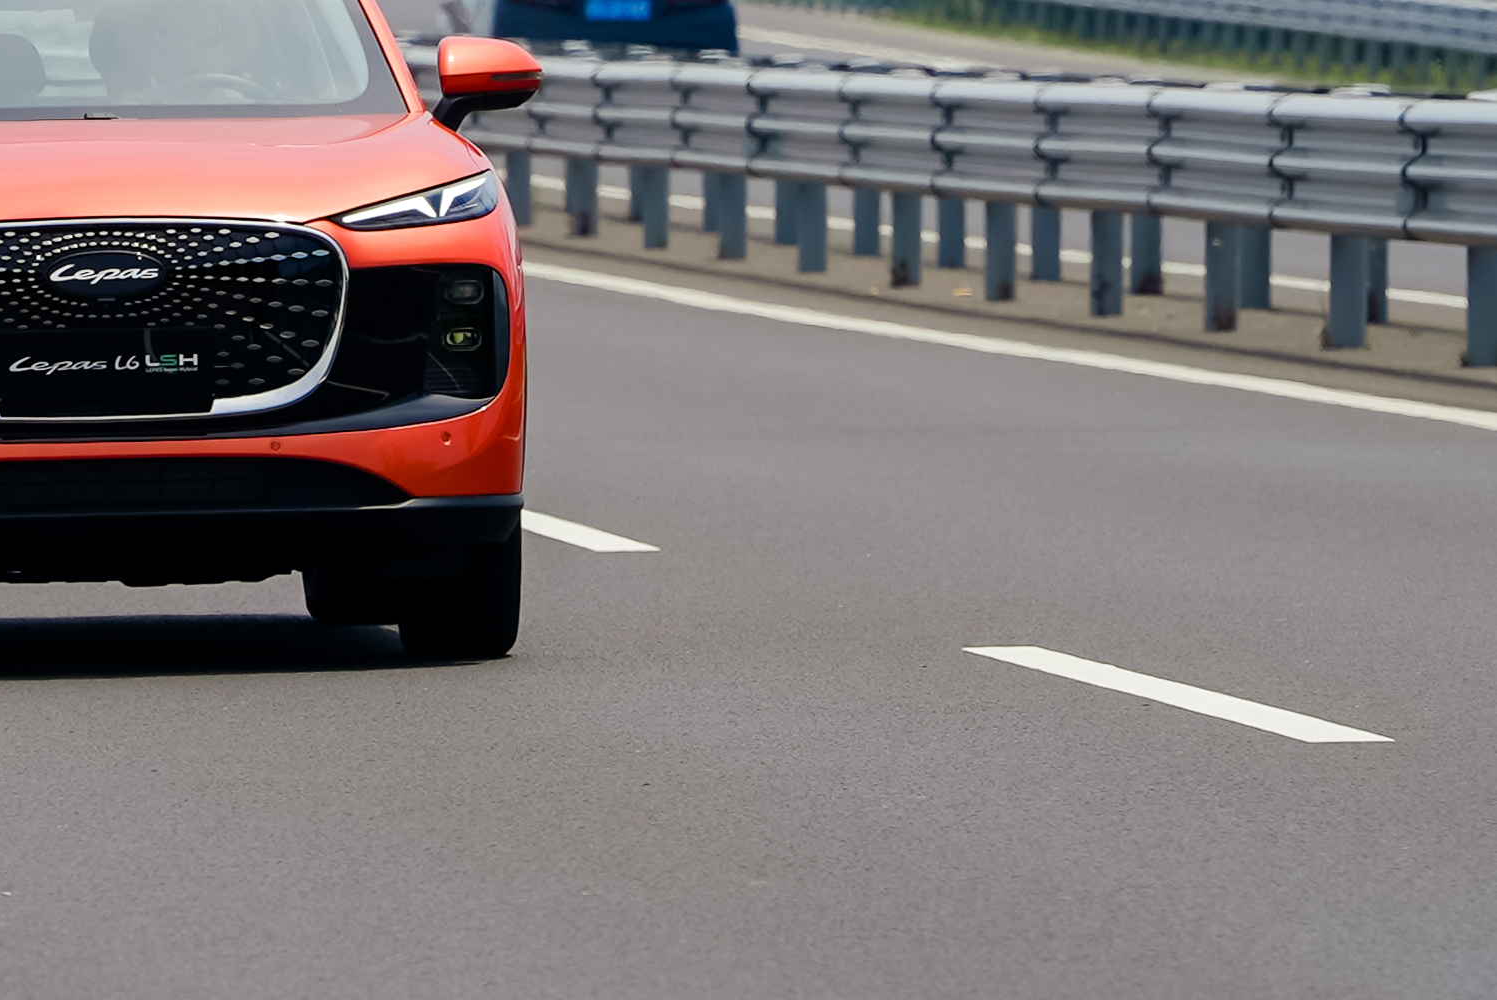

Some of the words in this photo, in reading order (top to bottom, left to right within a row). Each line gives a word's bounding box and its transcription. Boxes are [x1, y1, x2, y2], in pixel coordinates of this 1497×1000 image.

[49, 263, 159, 285] Lepas
[9, 356, 107, 375] Lepas
[114, 355, 140, 371] L6
[145, 353, 198, 367] LSH
